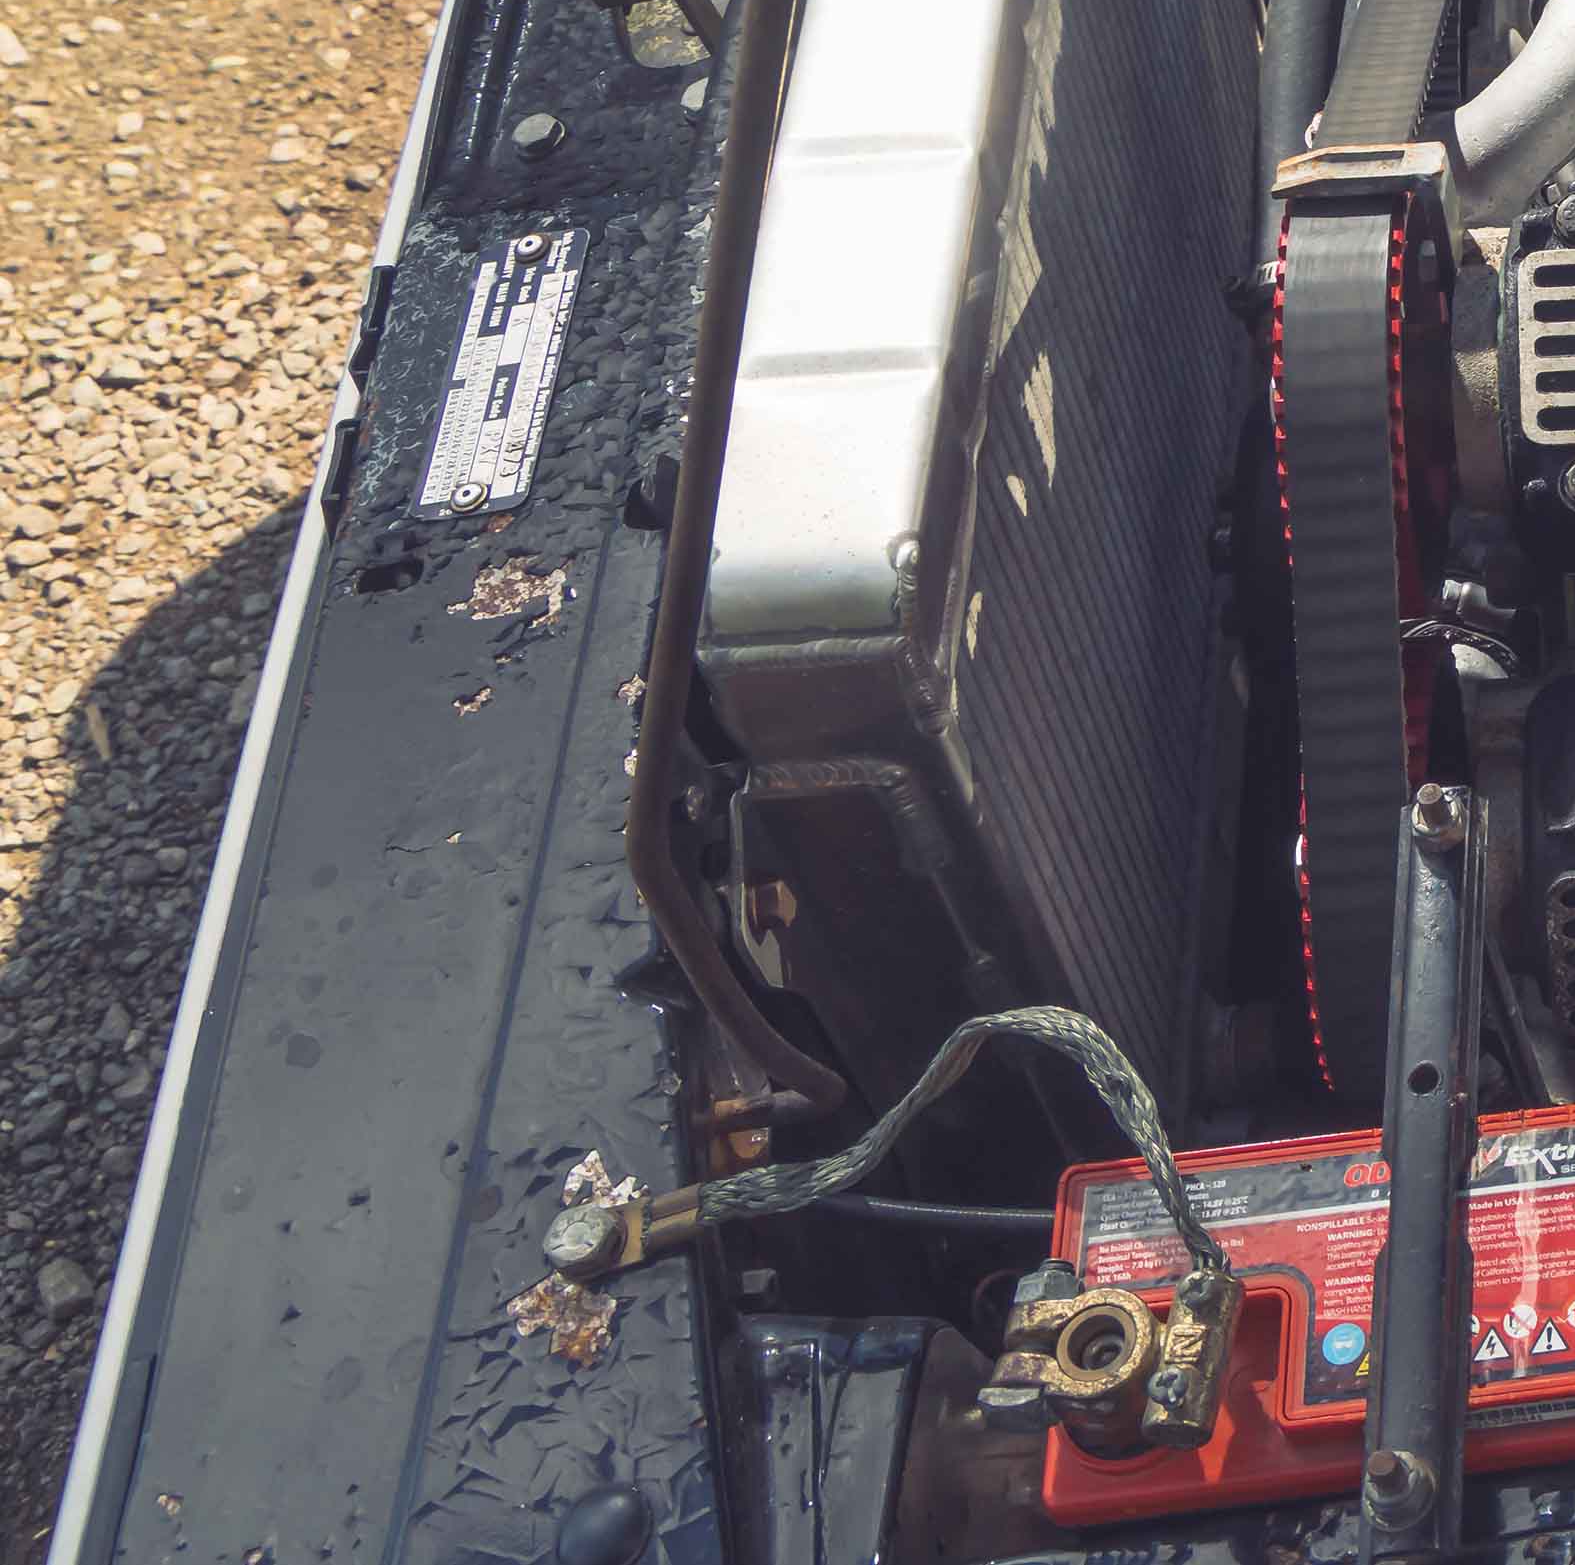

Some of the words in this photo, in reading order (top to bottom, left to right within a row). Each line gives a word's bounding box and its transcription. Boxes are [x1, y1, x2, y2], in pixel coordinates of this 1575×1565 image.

[1297, 1216, 1363, 1232] NONSPILLABLE
[1327, 1228, 1374, 1241] WARNING:
[1325, 1273, 1373, 1286] WARNING:
